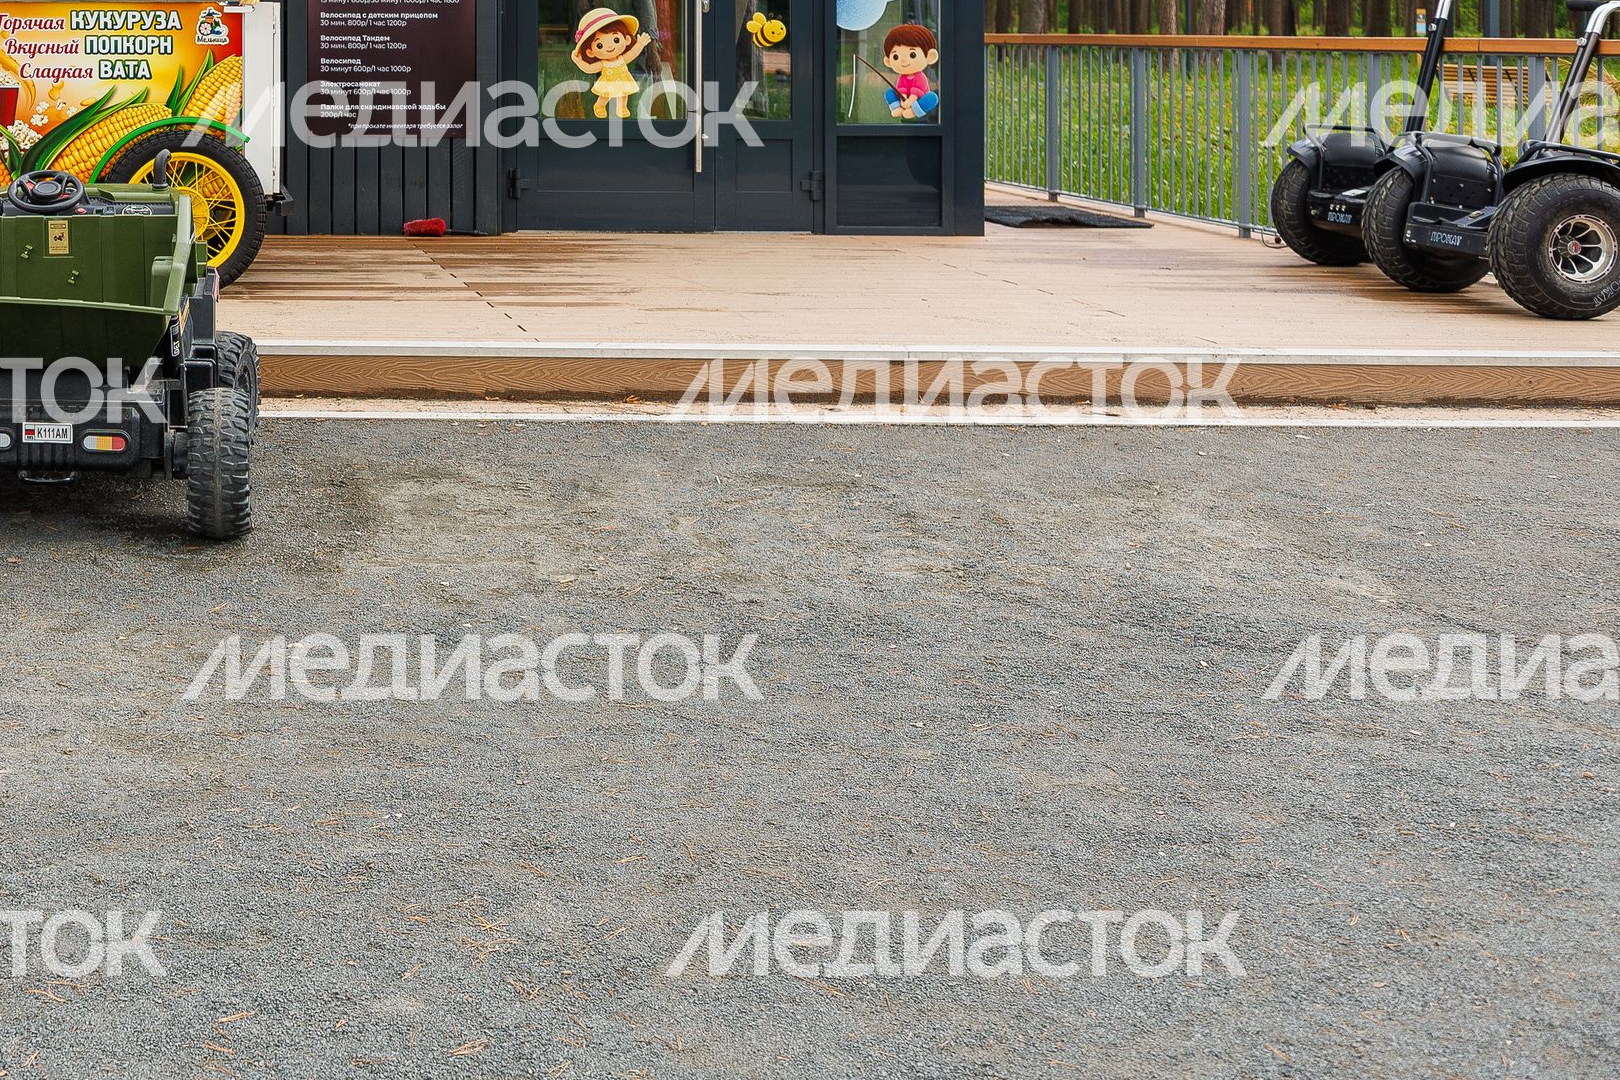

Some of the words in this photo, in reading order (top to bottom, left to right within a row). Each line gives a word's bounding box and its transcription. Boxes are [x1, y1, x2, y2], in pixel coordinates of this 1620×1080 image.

[70, 10, 182, 30] КУКУРУЗА
[320, 12, 361, 20] Велосипед
[320, 35, 362, 43] Велосипед
[362, 35, 390, 43] Тандем
[4, 38, 79, 57] Вкусный
[84, 34, 174, 55] ПОПКОРН
[347, 42, 369, 50] 800р/
[386, 42, 407, 50] 1200р
[320, 57, 361, 66] Велосипед
[19, 62, 93, 83] Сладкая
[98, 59, 153, 80] ВАТА
[353, 65, 376, 73] 600р/1
[390, 65, 411, 73] 1000р
[1327, 211, 1353, 224] ПРОКАТ
[1430, 231, 1463, 247] ПРОКАТ
